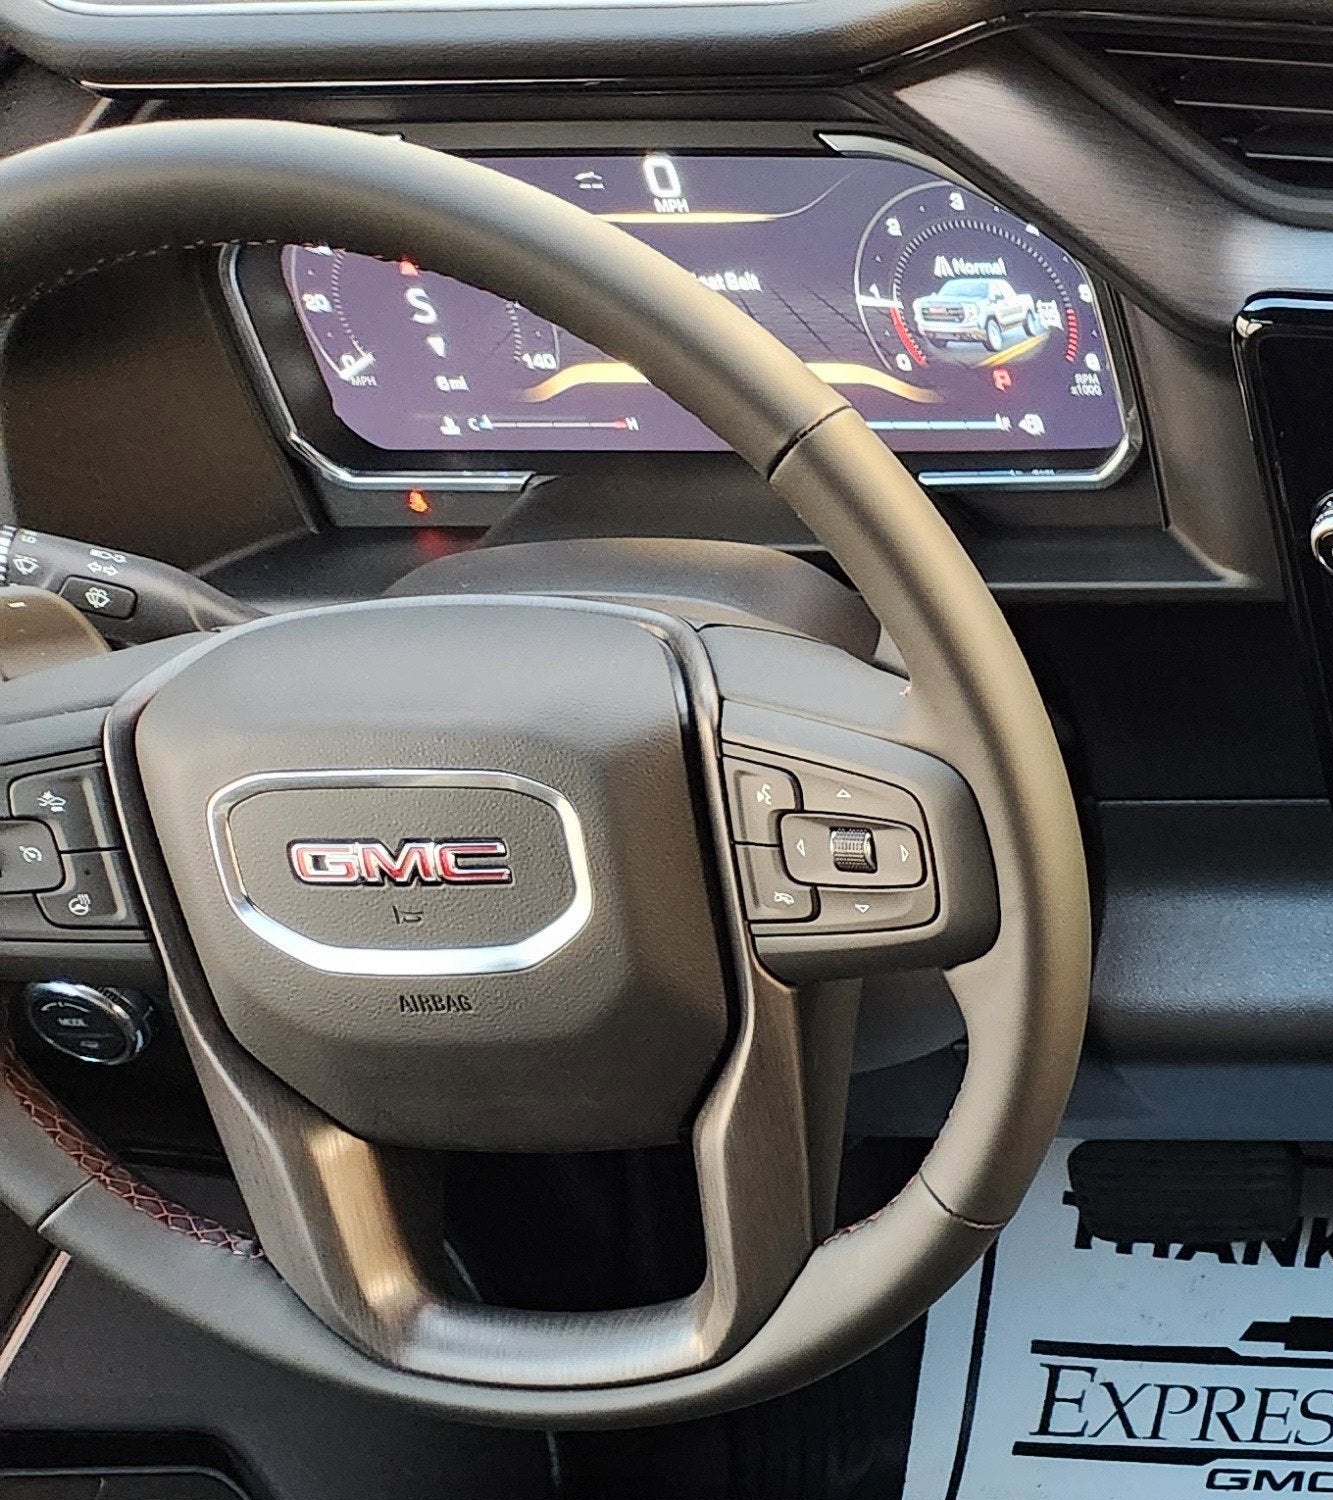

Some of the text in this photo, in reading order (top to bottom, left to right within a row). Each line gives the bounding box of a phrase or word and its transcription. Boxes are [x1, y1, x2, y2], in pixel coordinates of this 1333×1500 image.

[643, 155, 681, 198] 0
[653, 198, 690, 213] MPH
[953, 257, 1008, 276] Normal
[404, 287, 438, 325] S
[287, 838, 513, 887] GMC
[399, 994, 473, 1013] AIRBAG
